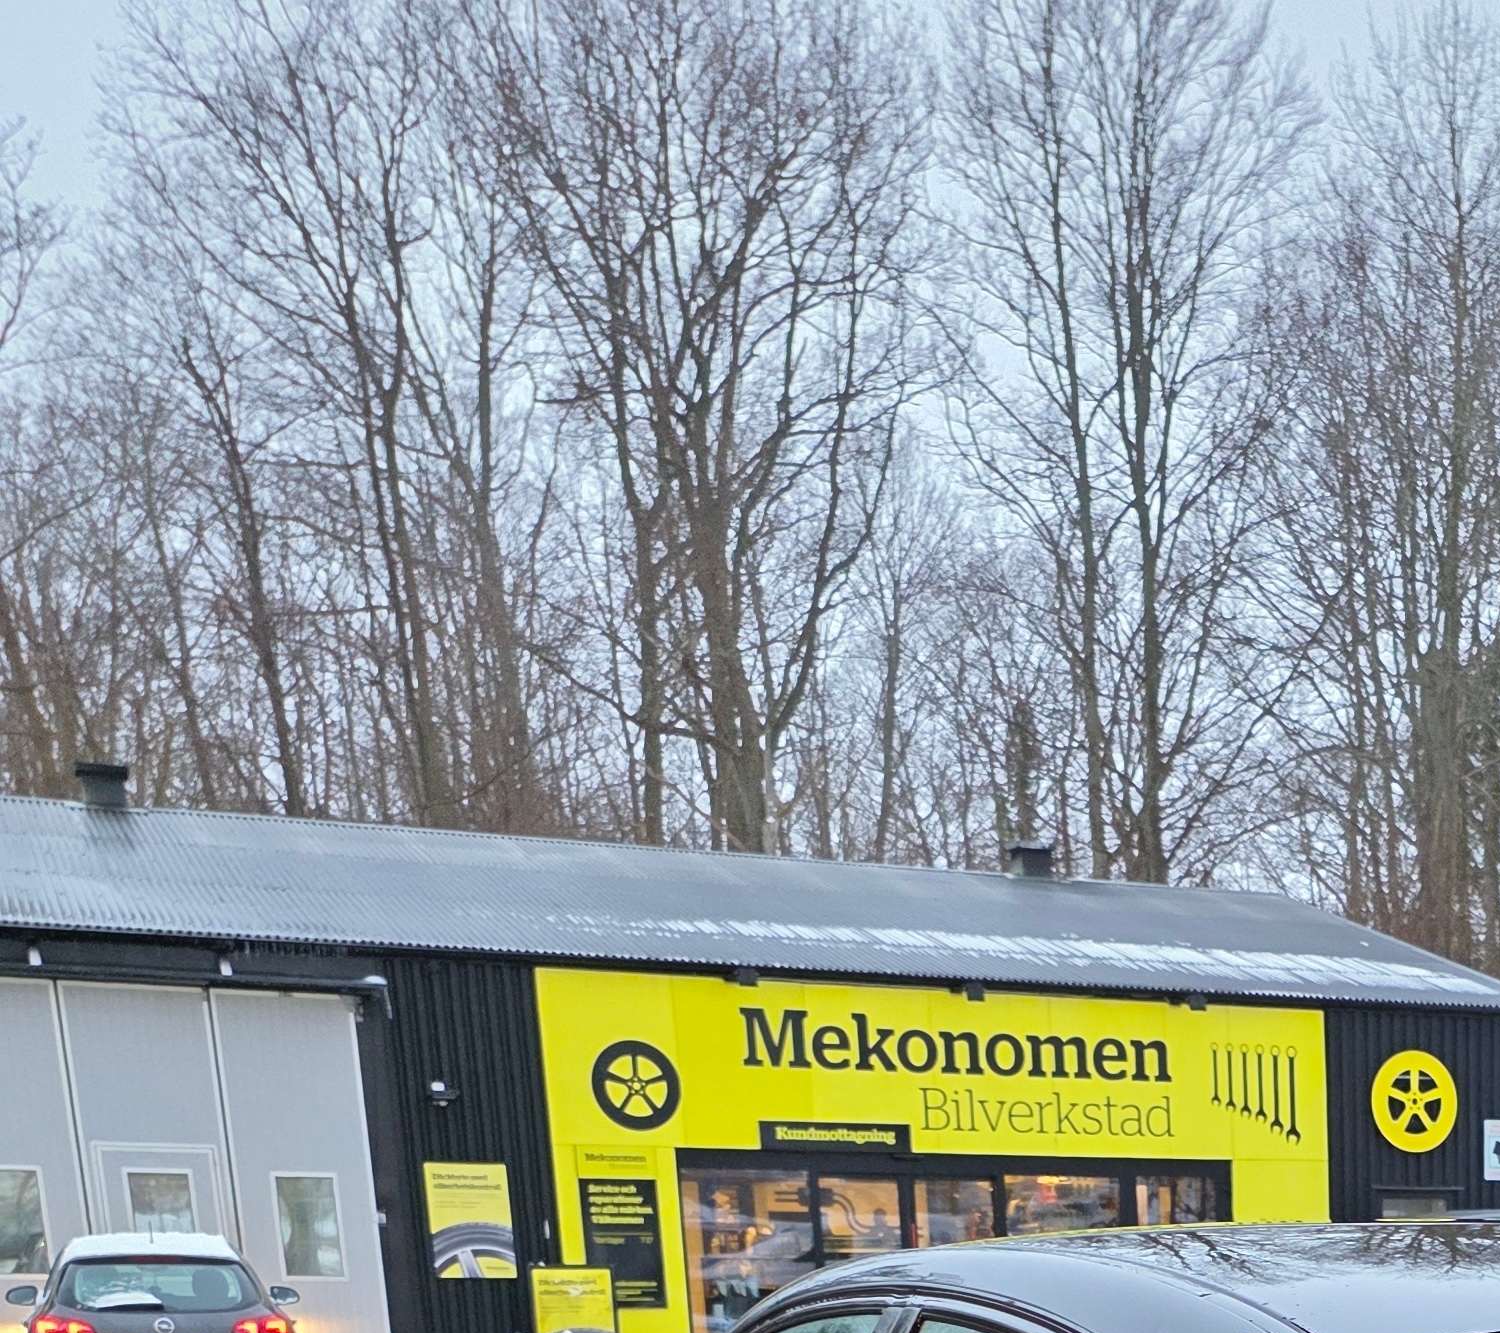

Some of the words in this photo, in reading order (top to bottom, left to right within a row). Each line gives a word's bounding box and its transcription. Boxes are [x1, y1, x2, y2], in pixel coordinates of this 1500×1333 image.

[739, 1007, 1172, 1083] Mekonomen
[775, 1125, 896, 1145] Kundmottagning
[919, 1087, 1175, 1137] Bilverkstad
